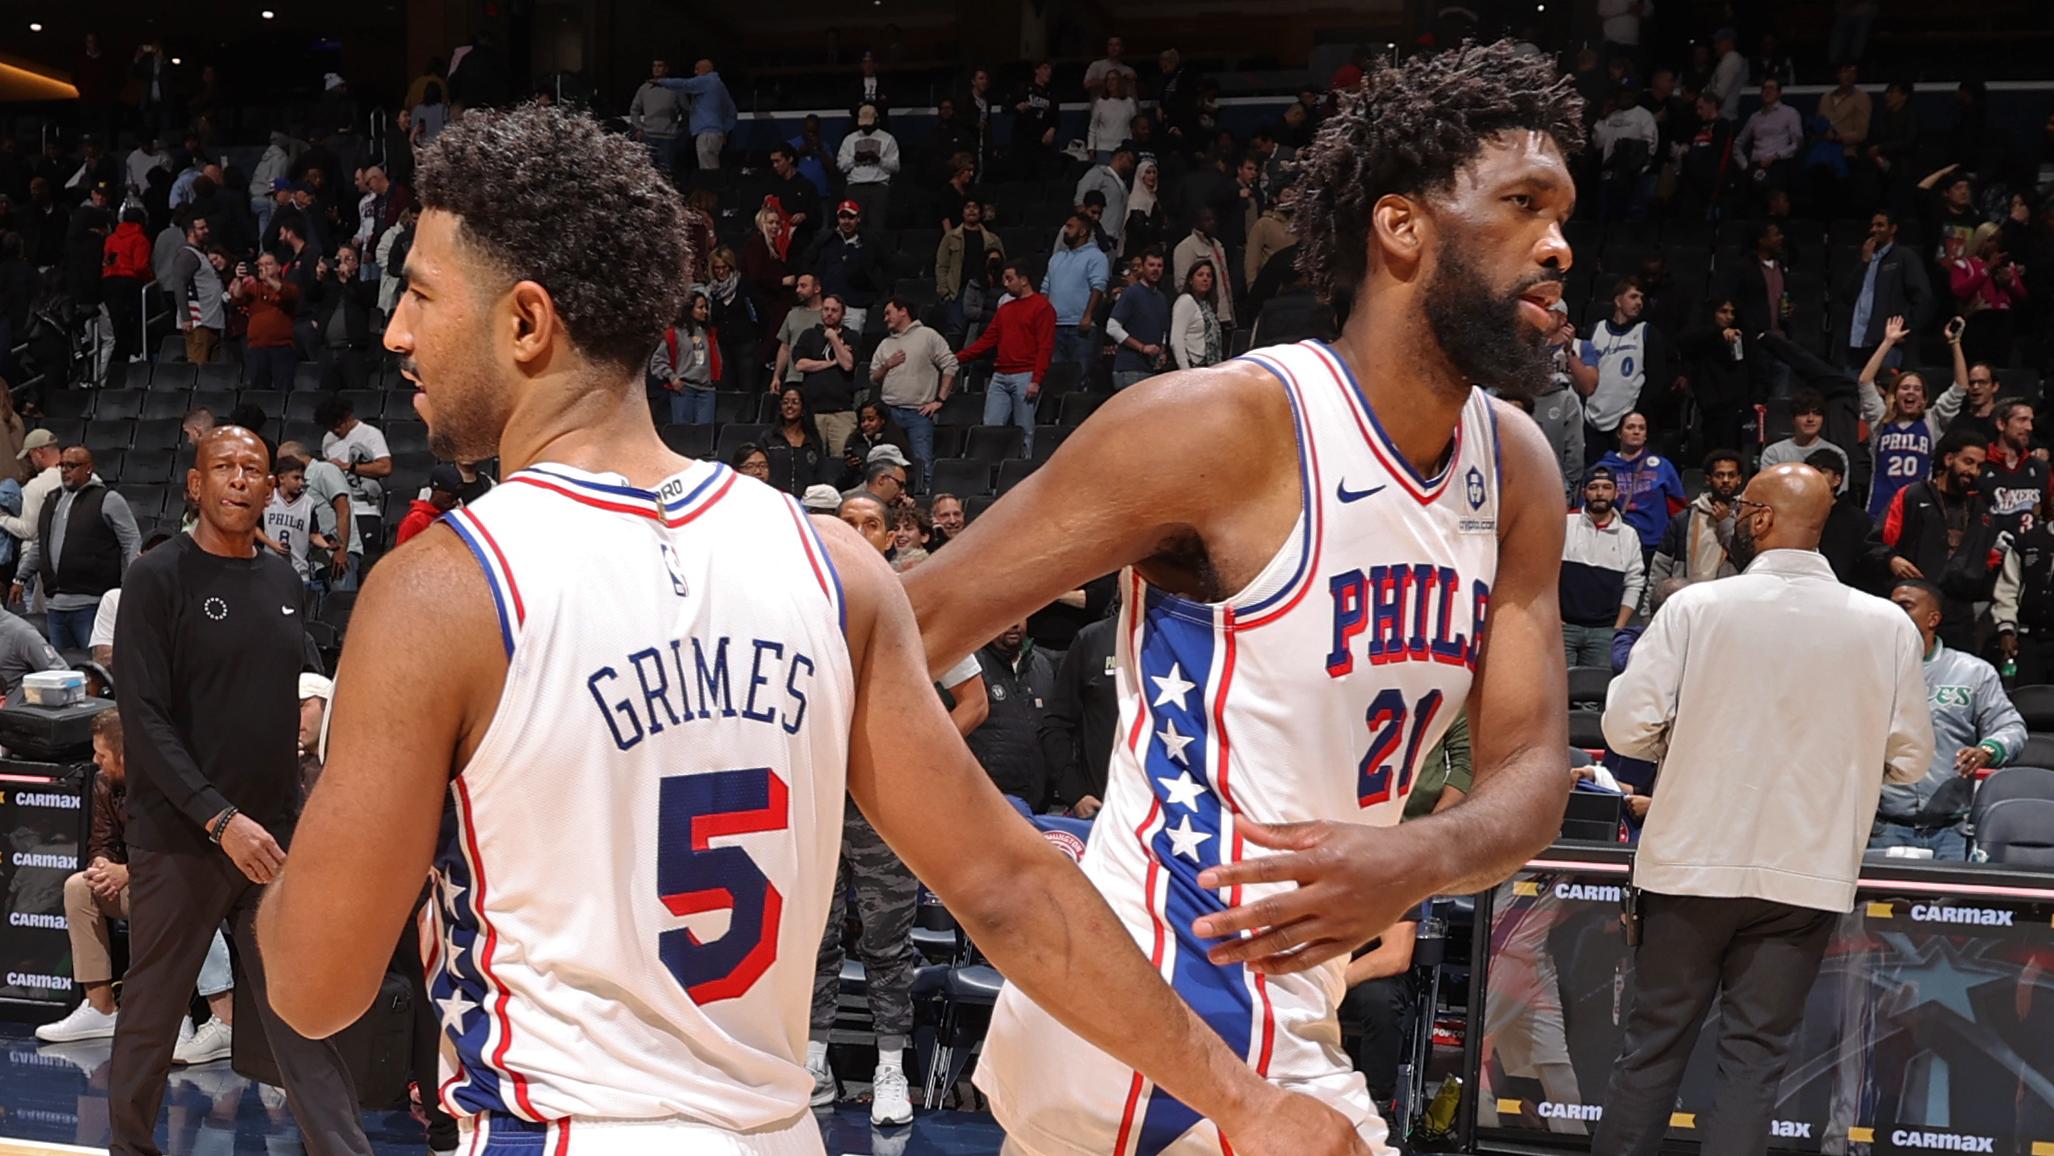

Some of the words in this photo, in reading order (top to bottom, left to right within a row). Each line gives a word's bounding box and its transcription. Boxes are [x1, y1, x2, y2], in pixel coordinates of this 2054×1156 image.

[1621, 356, 1634, 378] 0
[1880, 432, 1929, 455] PHILA
[1887, 455, 1918, 477] 20
[268, 512, 304, 531] PHILA
[587, 636, 815, 751] GRIMES
[1357, 688, 1443, 810] 21
[15, 791, 81, 809] CARmax
[12, 852, 78, 870] CARmax
[657, 767, 788, 1007] 5
[1555, 883, 1621, 902] CARm
[1911, 904, 2013, 926] CARmax
[6, 971, 72, 990] CARmax
[1538, 1101, 1603, 1121] CARm
[1892, 1129, 1994, 1153] CARmax
